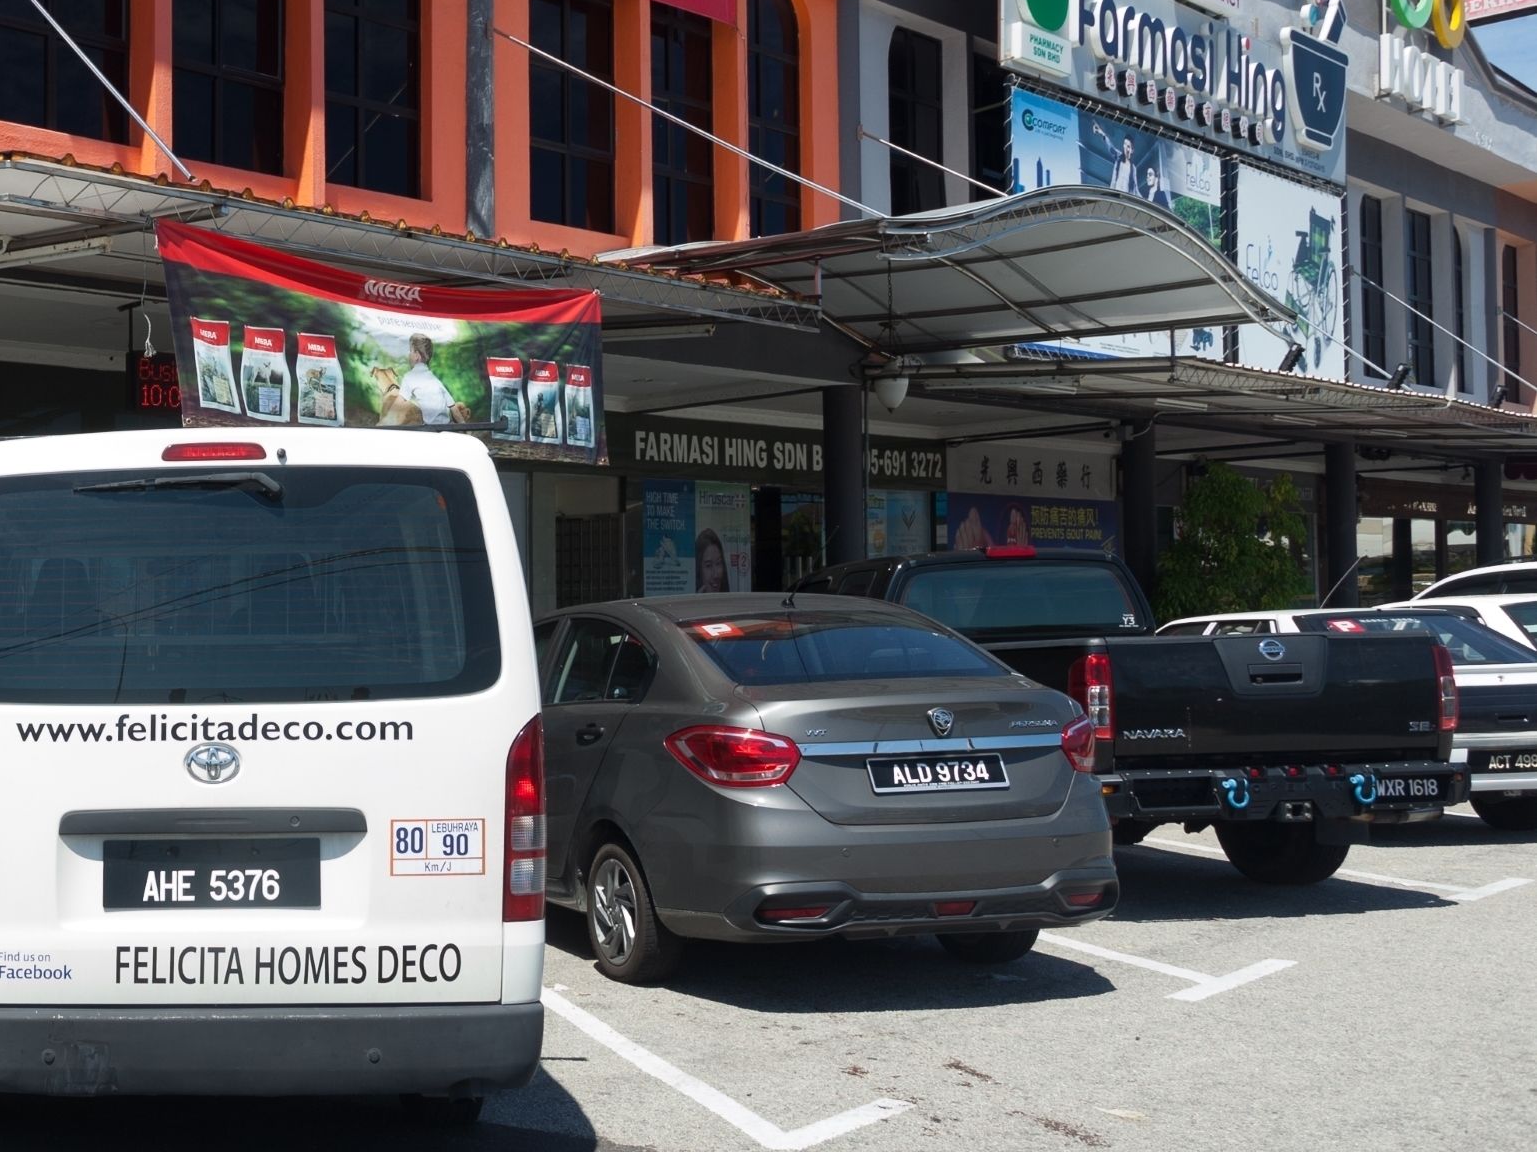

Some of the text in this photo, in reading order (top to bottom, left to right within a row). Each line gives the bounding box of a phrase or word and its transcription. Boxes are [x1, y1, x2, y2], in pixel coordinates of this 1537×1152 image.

[1029, 33, 1063, 54] PHARMACY
[1033, 46, 1061, 64] SDN BHD
[1226, 30, 1286, 143] Hing
[1185, 160, 1211, 192] Felco
[1246, 243, 1278, 291] Felco
[364, 279, 423, 302] MERA
[199, 328, 217, 340] MERA
[254, 336, 273, 347] MERA
[307, 342, 326, 353] MERA
[495, 366, 514, 374] MERA
[635, 430, 719, 466] FARMASI
[725, 437, 767, 469] HING
[773, 441, 808, 472] SDN
[911, 450, 943, 479] 3272
[645, 491, 679, 504] HIGH TIME
[699, 490, 735, 506] Hiruscar
[647, 505, 676, 517] TO MAKE
[647, 518, 659, 529] THE
[1031, 528, 1064, 539] PREVENTS
[1066, 529, 1084, 540] GOUT
[1122, 616, 1135, 625] Y3
[16, 713, 414, 743] www.felicitadeco.com
[1123, 728, 1186, 740] NAVARA
[1488, 755, 1511, 769] ACT
[893, 760, 990, 785] ALD 9734
[1375, 779, 1439, 796] WXR 1618
[431, 821, 479, 835] LEBUHRAYA
[396, 825, 424, 855] 80
[442, 833, 470, 857] 90
[424, 861, 452, 874] Km/J
[142, 869, 281, 902] AHE 5376
[23, 954, 33, 963] us
[37, 954, 51, 963] on
[115, 943, 462, 985] FELICITA HOMES DECO
